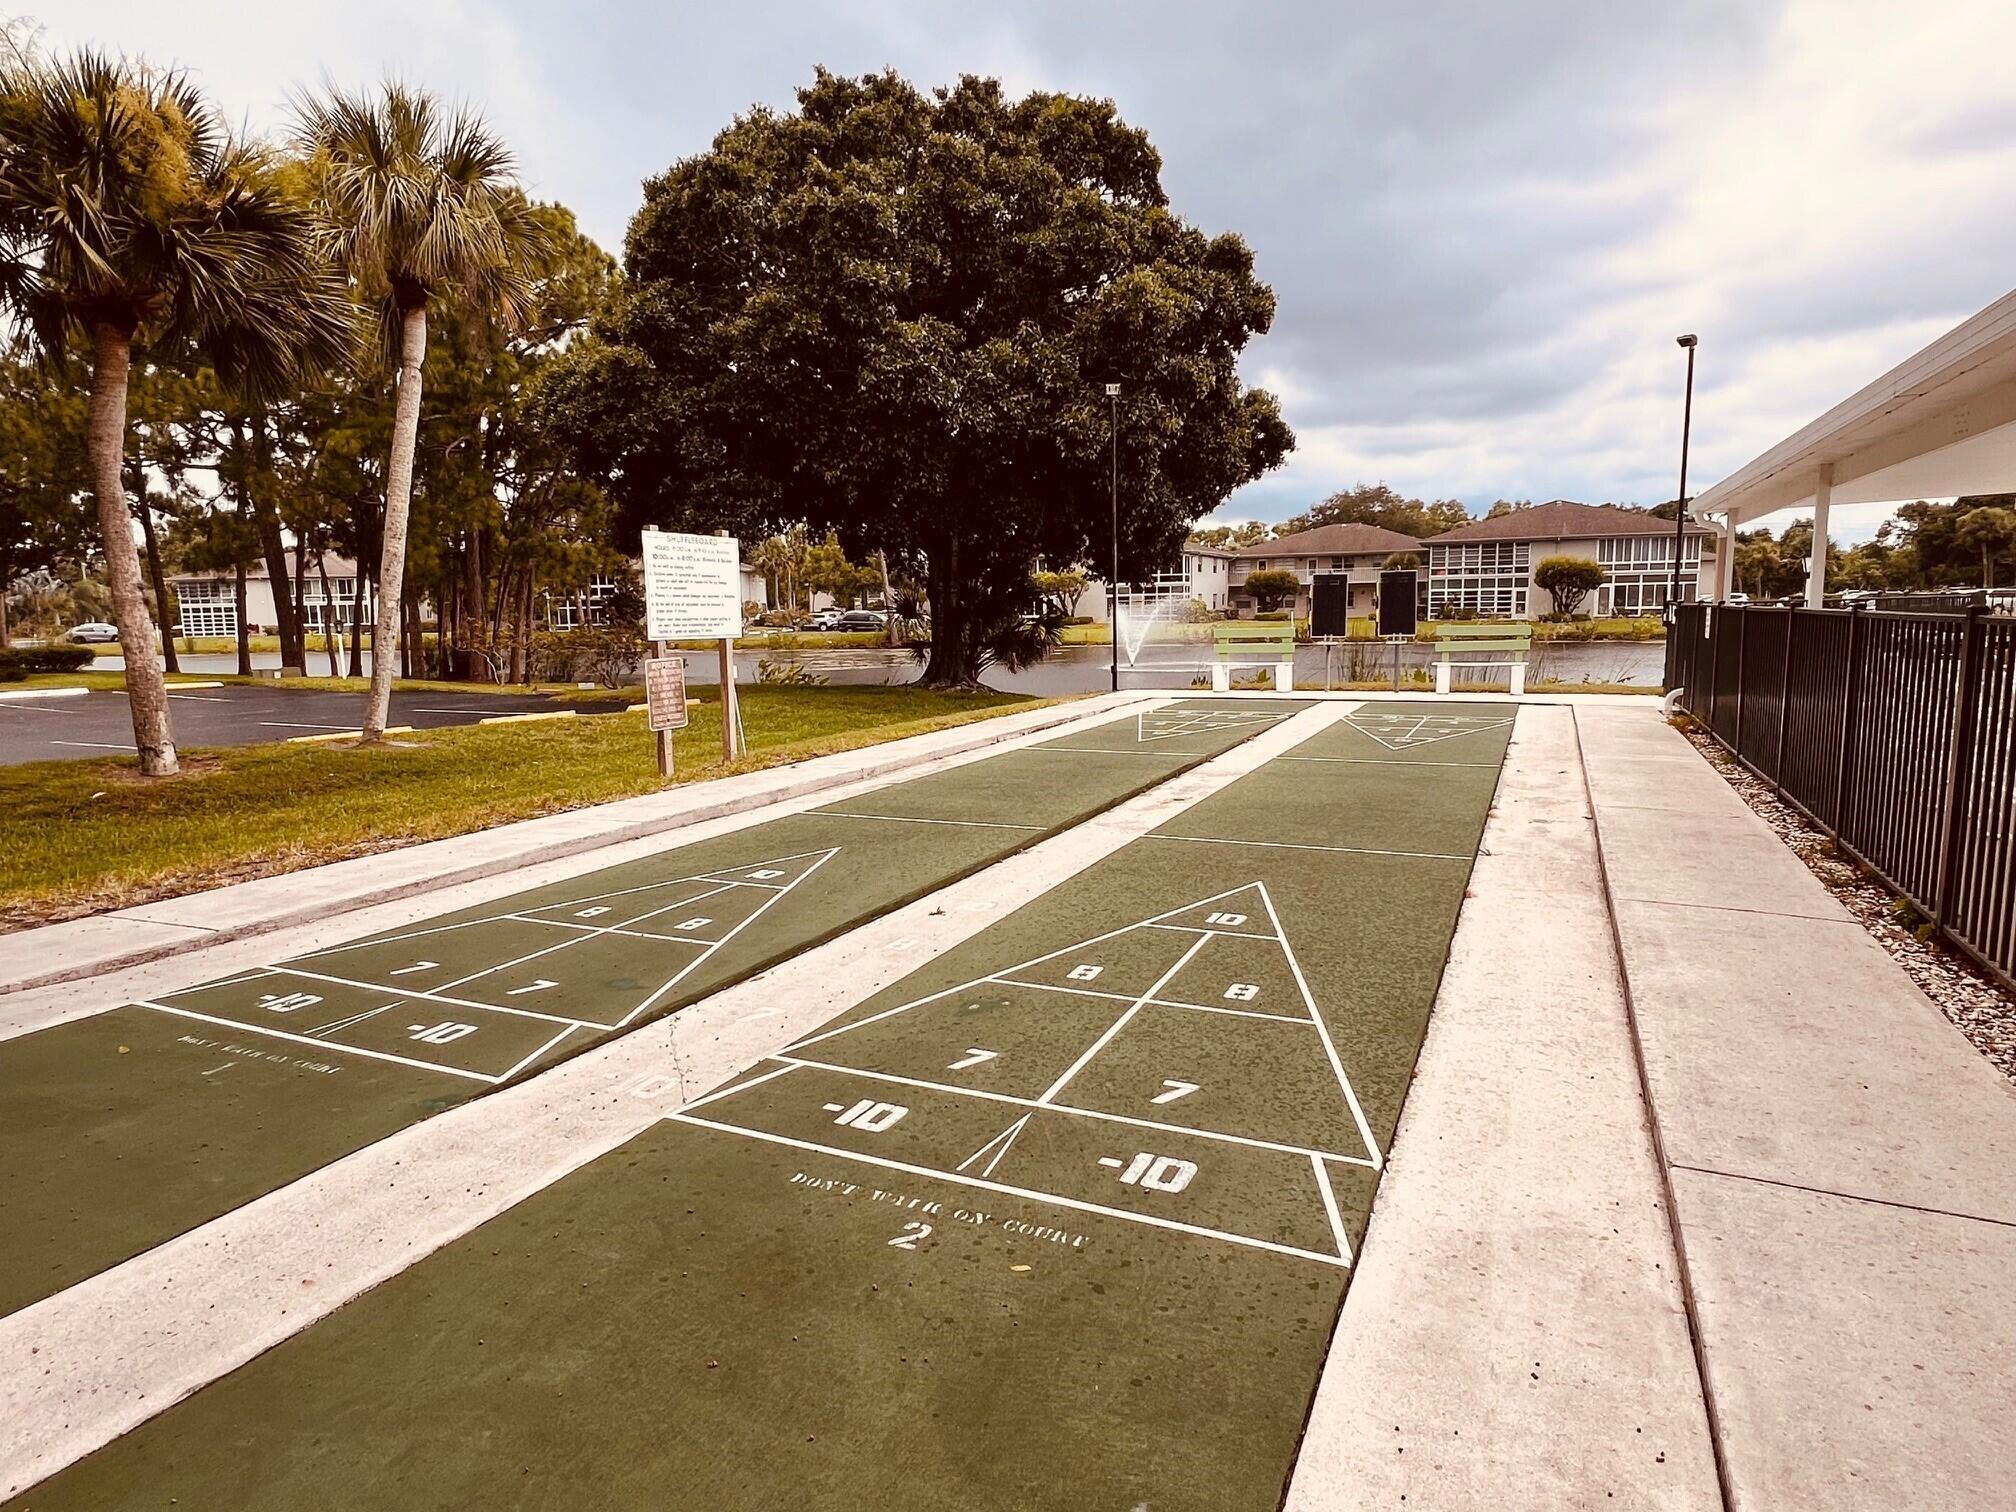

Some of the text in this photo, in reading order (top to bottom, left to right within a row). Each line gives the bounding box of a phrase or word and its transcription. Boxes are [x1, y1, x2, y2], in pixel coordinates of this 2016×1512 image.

[574, 905, 613, 918] 8
[1205, 913, 1248, 926] 10
[674, 918, 713, 931] 8
[390, 962, 439, 975] 7
[1066, 964, 1105, 981] 8
[506, 979, 560, 995] 7
[1223, 983, 1260, 1000] 8
[407, 1021, 478, 1044] -10
[947, 1048, 1001, 1070] 7
[1150, 1079, 1201, 1104] 7
[822, 1099, 910, 1132] -10
[1098, 1152, 1198, 1194] -10
[790, 1172, 1090, 1248] DON'T WALK ON COURT
[888, 1222, 933, 1250] 2
